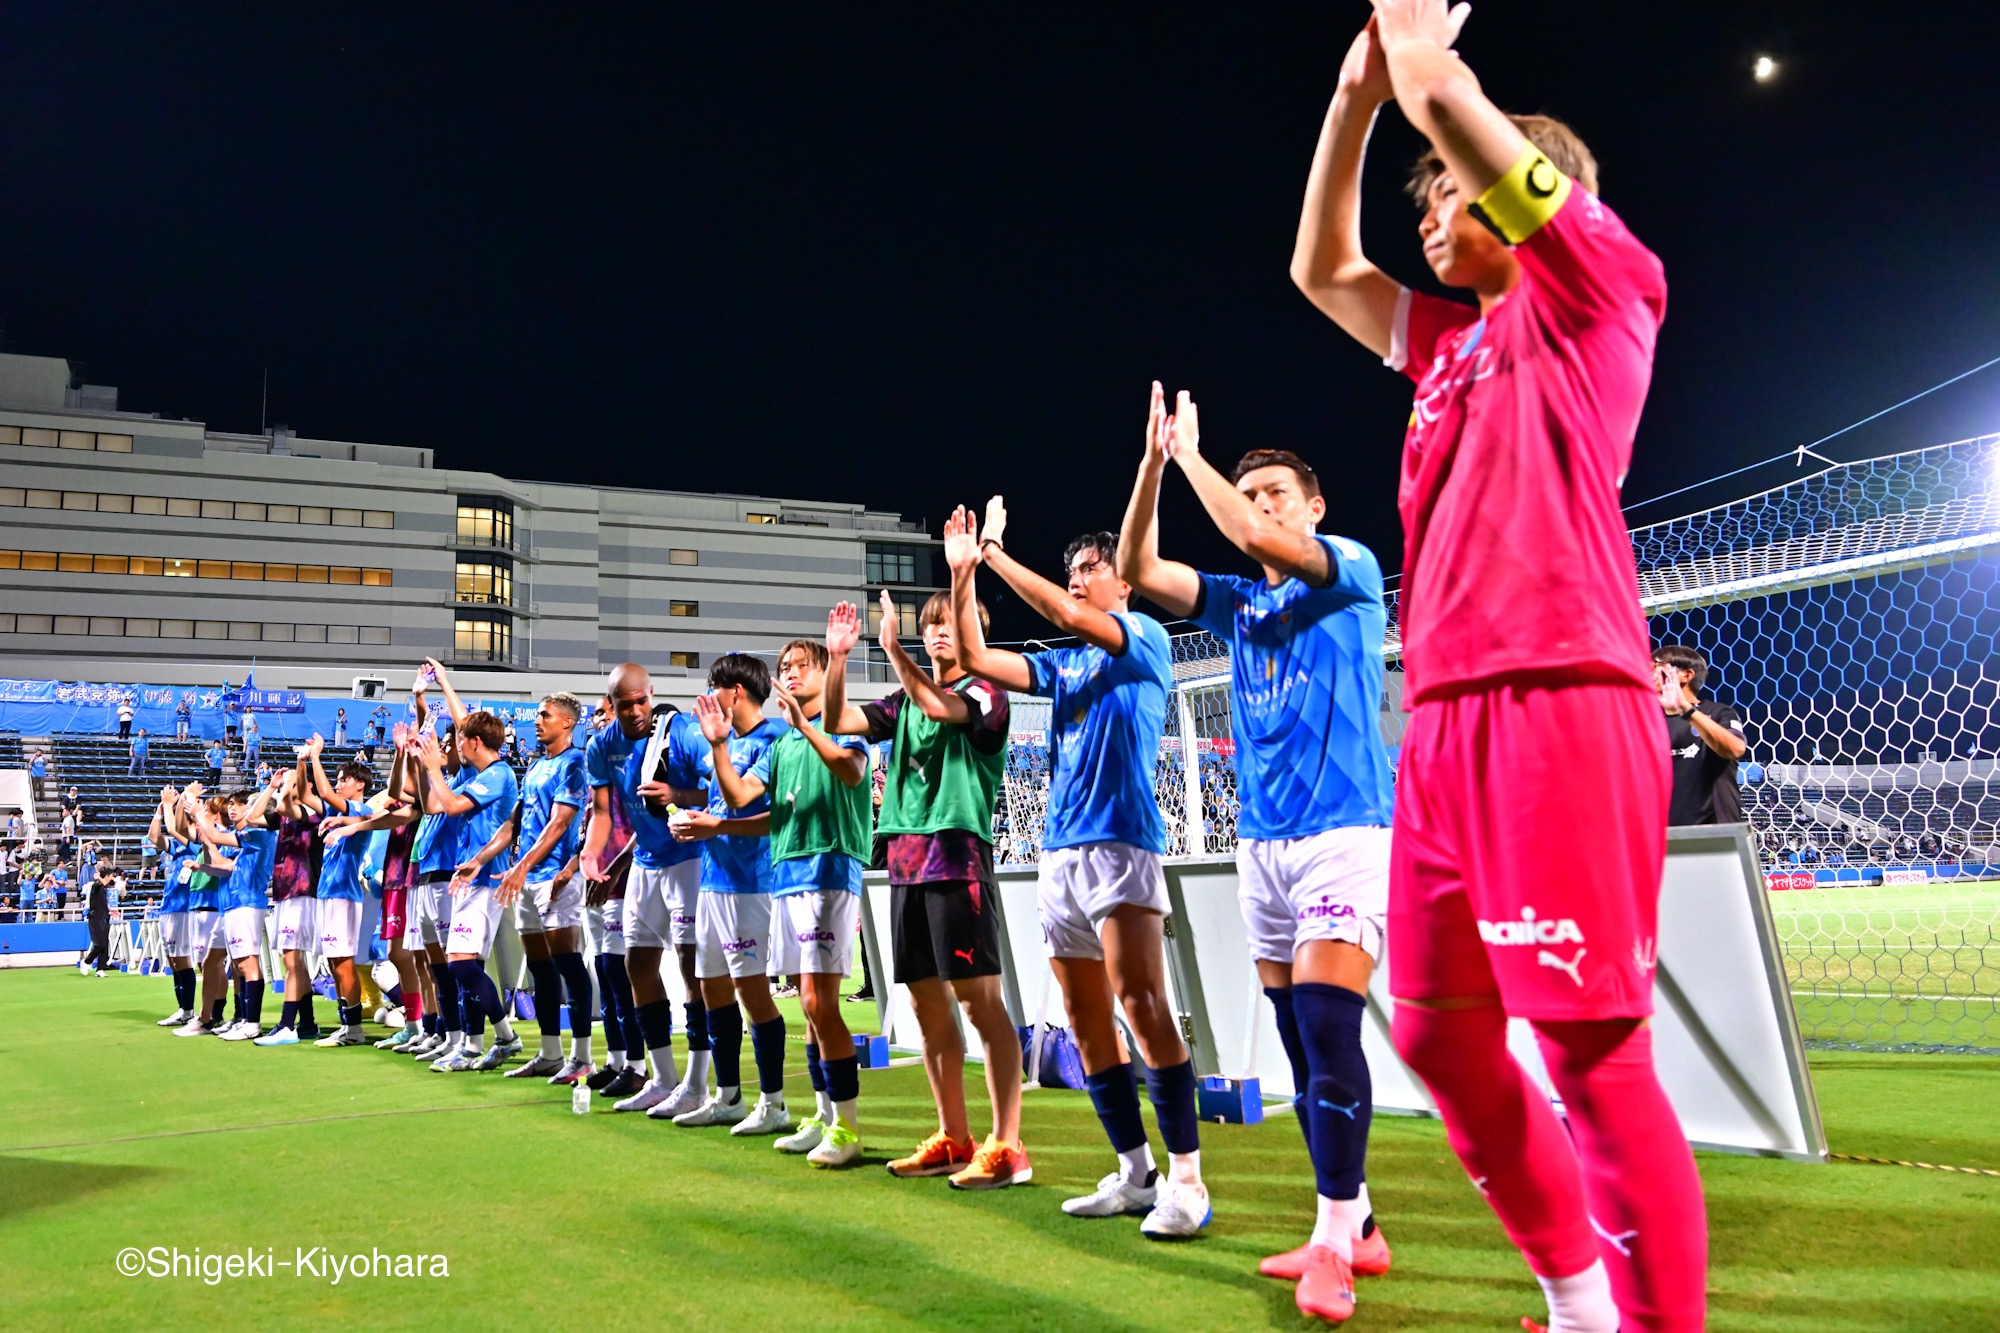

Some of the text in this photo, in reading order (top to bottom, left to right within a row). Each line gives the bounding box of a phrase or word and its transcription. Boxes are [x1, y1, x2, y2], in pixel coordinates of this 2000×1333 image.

[1526, 157, 1558, 198] C
[56, 686, 121, 702] 岩武克弥
[110, 890, 118, 899] 25
